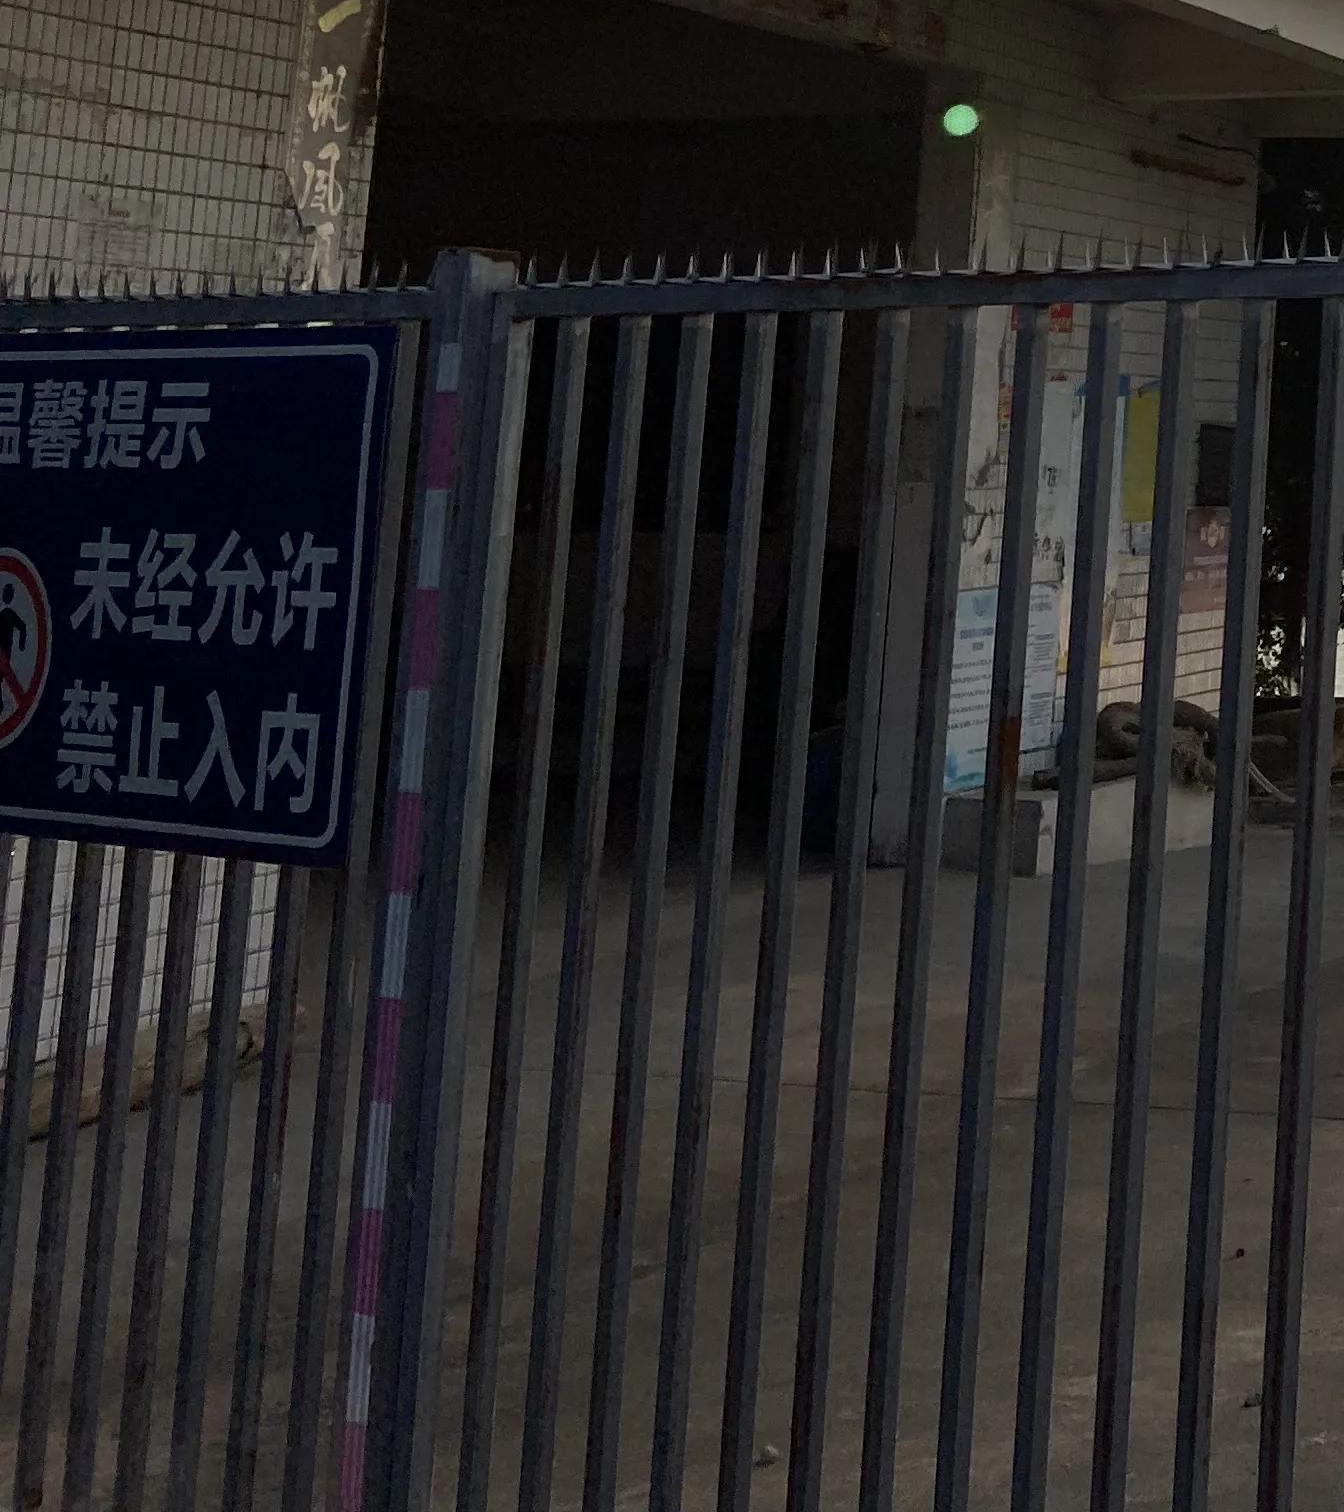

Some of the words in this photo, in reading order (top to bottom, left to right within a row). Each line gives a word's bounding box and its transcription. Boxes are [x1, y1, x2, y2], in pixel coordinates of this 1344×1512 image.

[69, 527, 339, 651] 未经允许
[56, 678, 322, 814] 禁止入内
